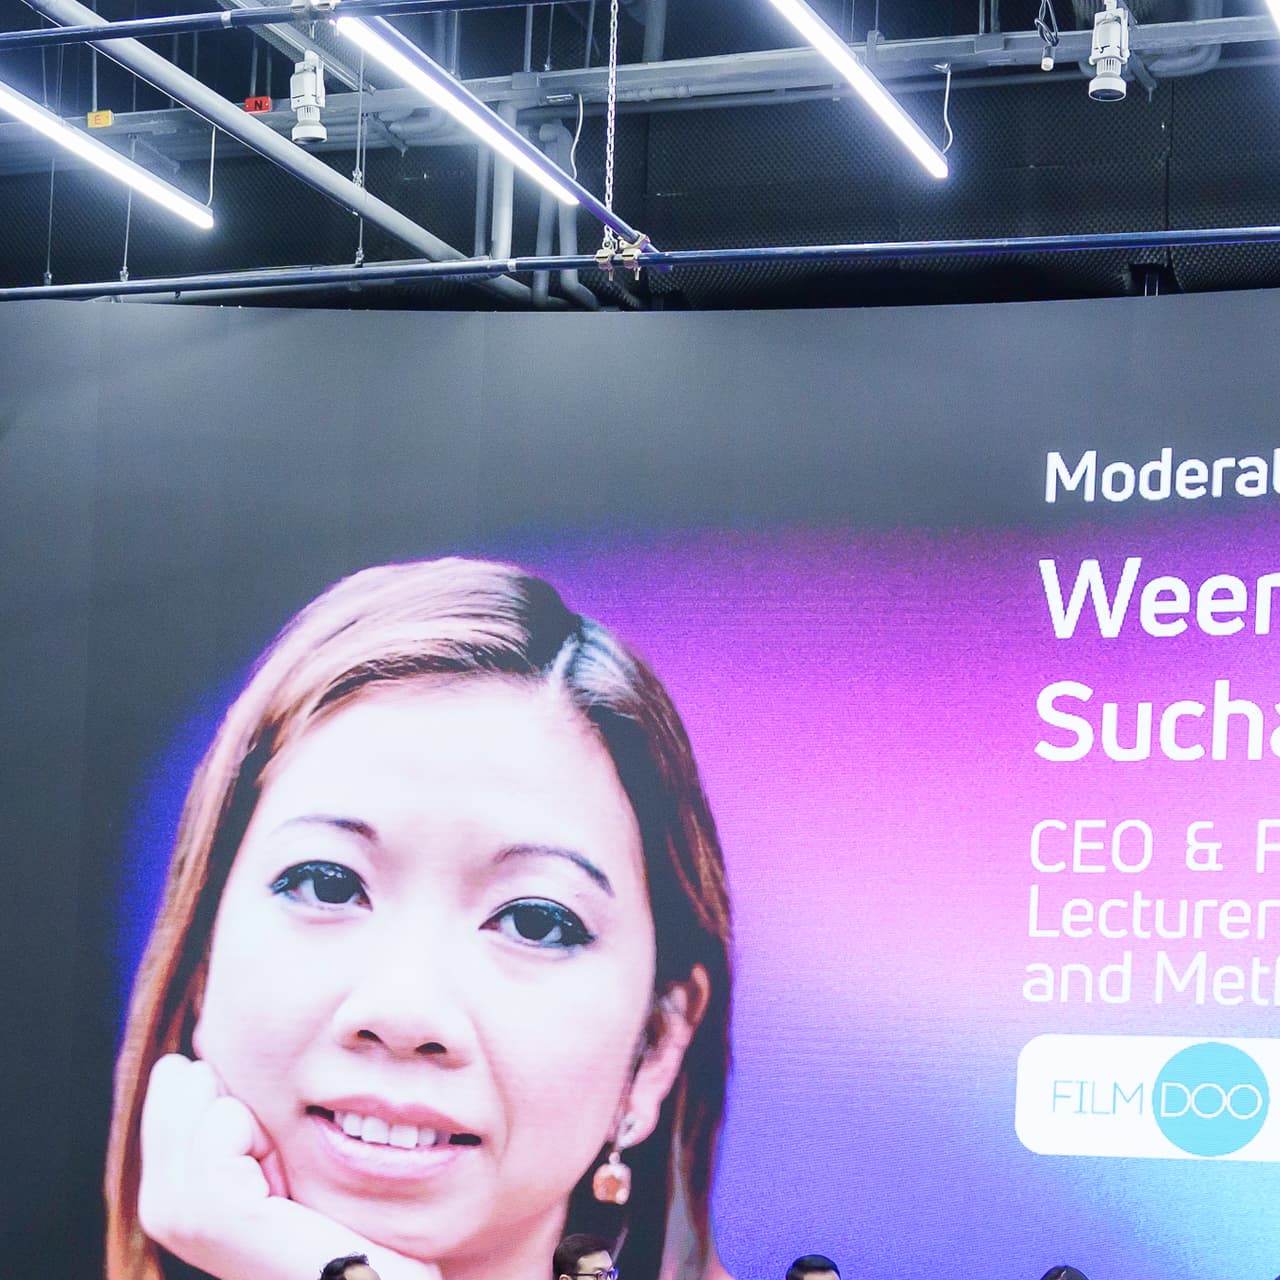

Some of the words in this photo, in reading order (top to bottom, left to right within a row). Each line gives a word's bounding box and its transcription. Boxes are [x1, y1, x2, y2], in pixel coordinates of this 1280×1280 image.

[253, 99, 263, 111] N
[1029, 818, 1154, 874] CEO
[1184, 820, 1224, 872] &
[1021, 950, 1133, 1004] and
